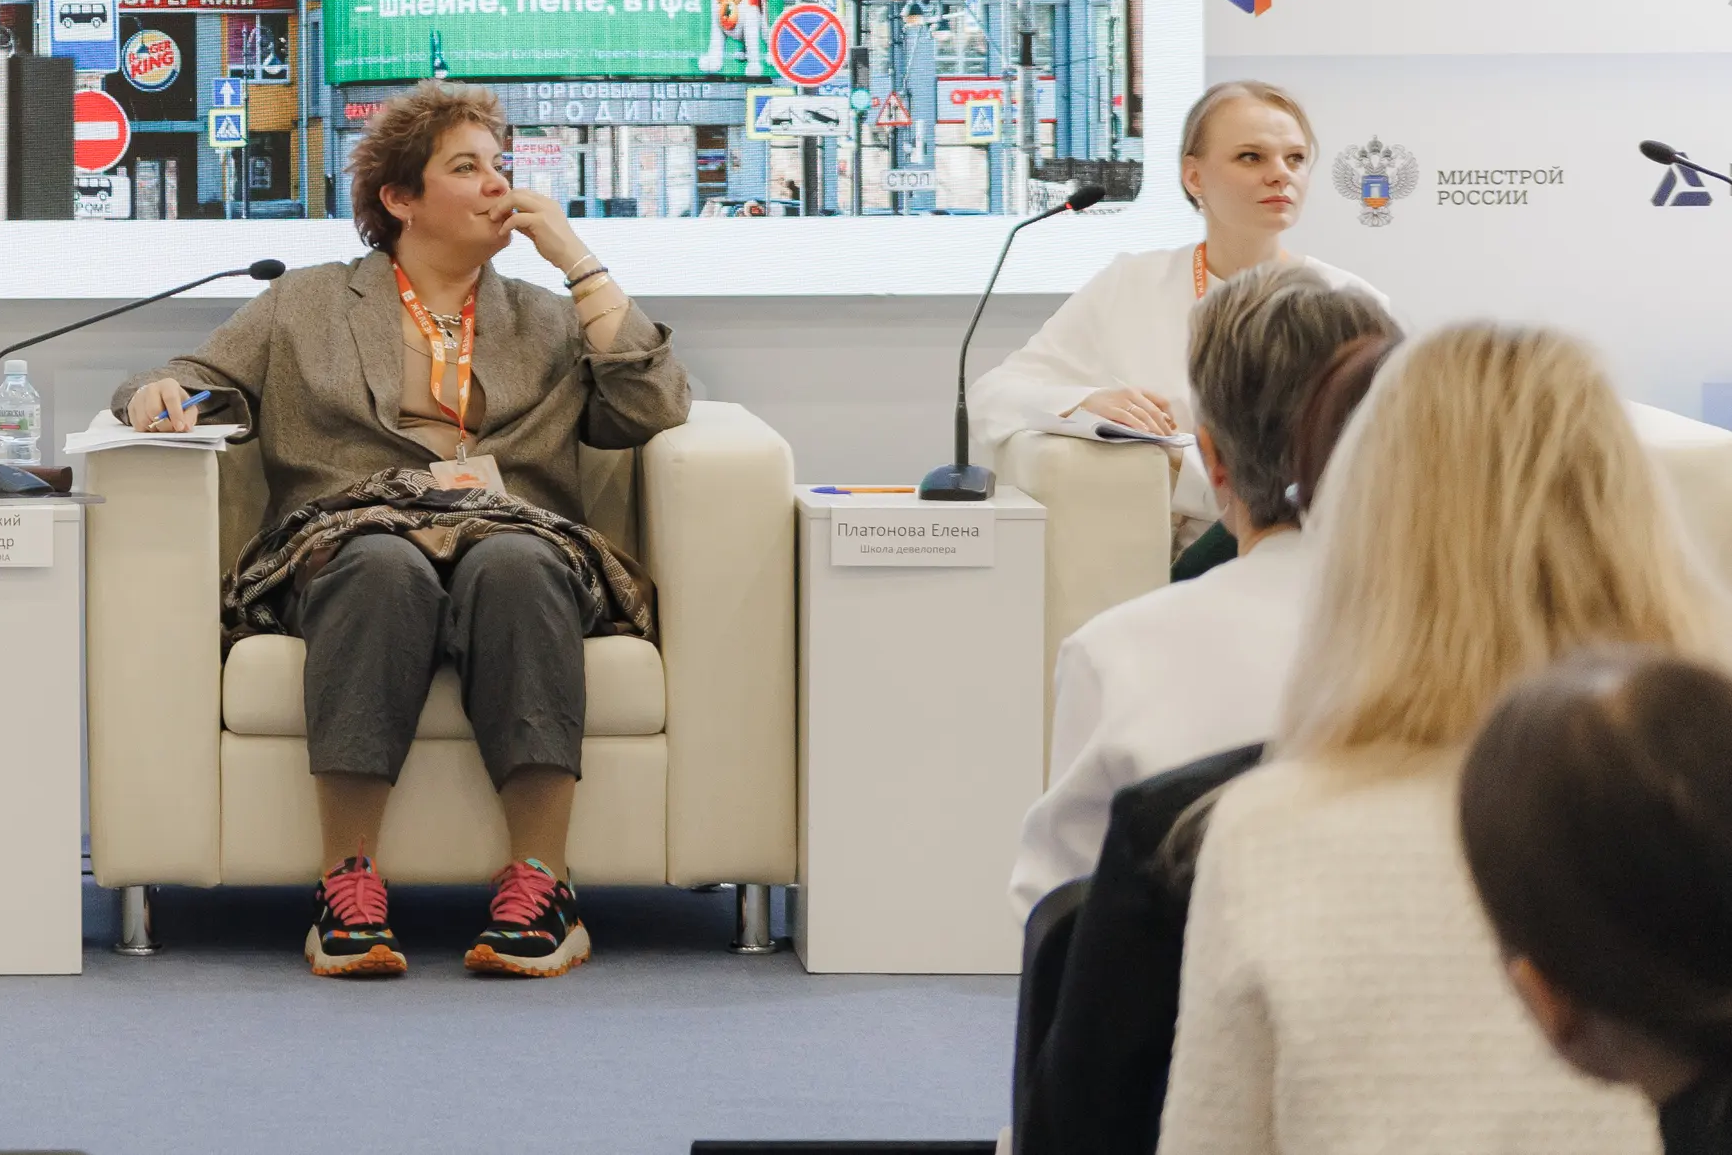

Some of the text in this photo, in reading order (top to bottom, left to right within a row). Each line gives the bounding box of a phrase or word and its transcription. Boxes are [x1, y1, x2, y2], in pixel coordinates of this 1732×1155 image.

[131, 51, 175, 79] KING
[524, 83, 711, 100] ТОРГОВЫЙ ЦЕНТР
[538, 100, 690, 122] РОДИНА
[886, 172, 931, 187] СТОП
[1437, 166, 1564, 185] МИНСТРОЙ
[1437, 189, 1529, 206] РОССИИ
[837, 522, 980, 537] Платонова Елена
[860, 544, 956, 554] Школа девелопера
